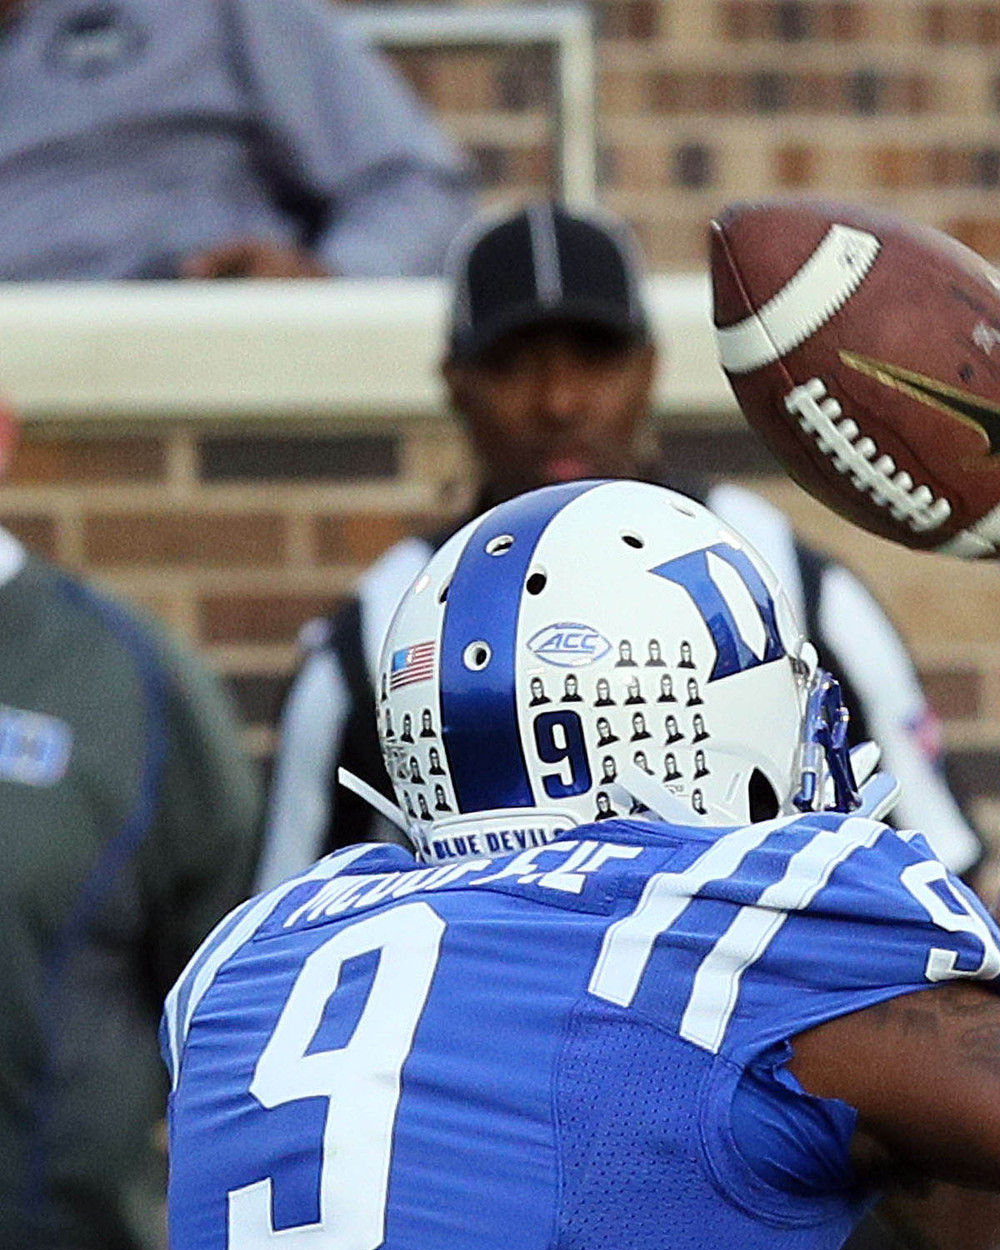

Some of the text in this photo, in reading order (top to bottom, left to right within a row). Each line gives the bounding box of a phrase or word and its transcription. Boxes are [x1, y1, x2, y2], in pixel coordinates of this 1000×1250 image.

[538, 632, 600, 651] ACC
[532, 709, 593, 800] 9
[432, 834, 481, 860] BLUE
